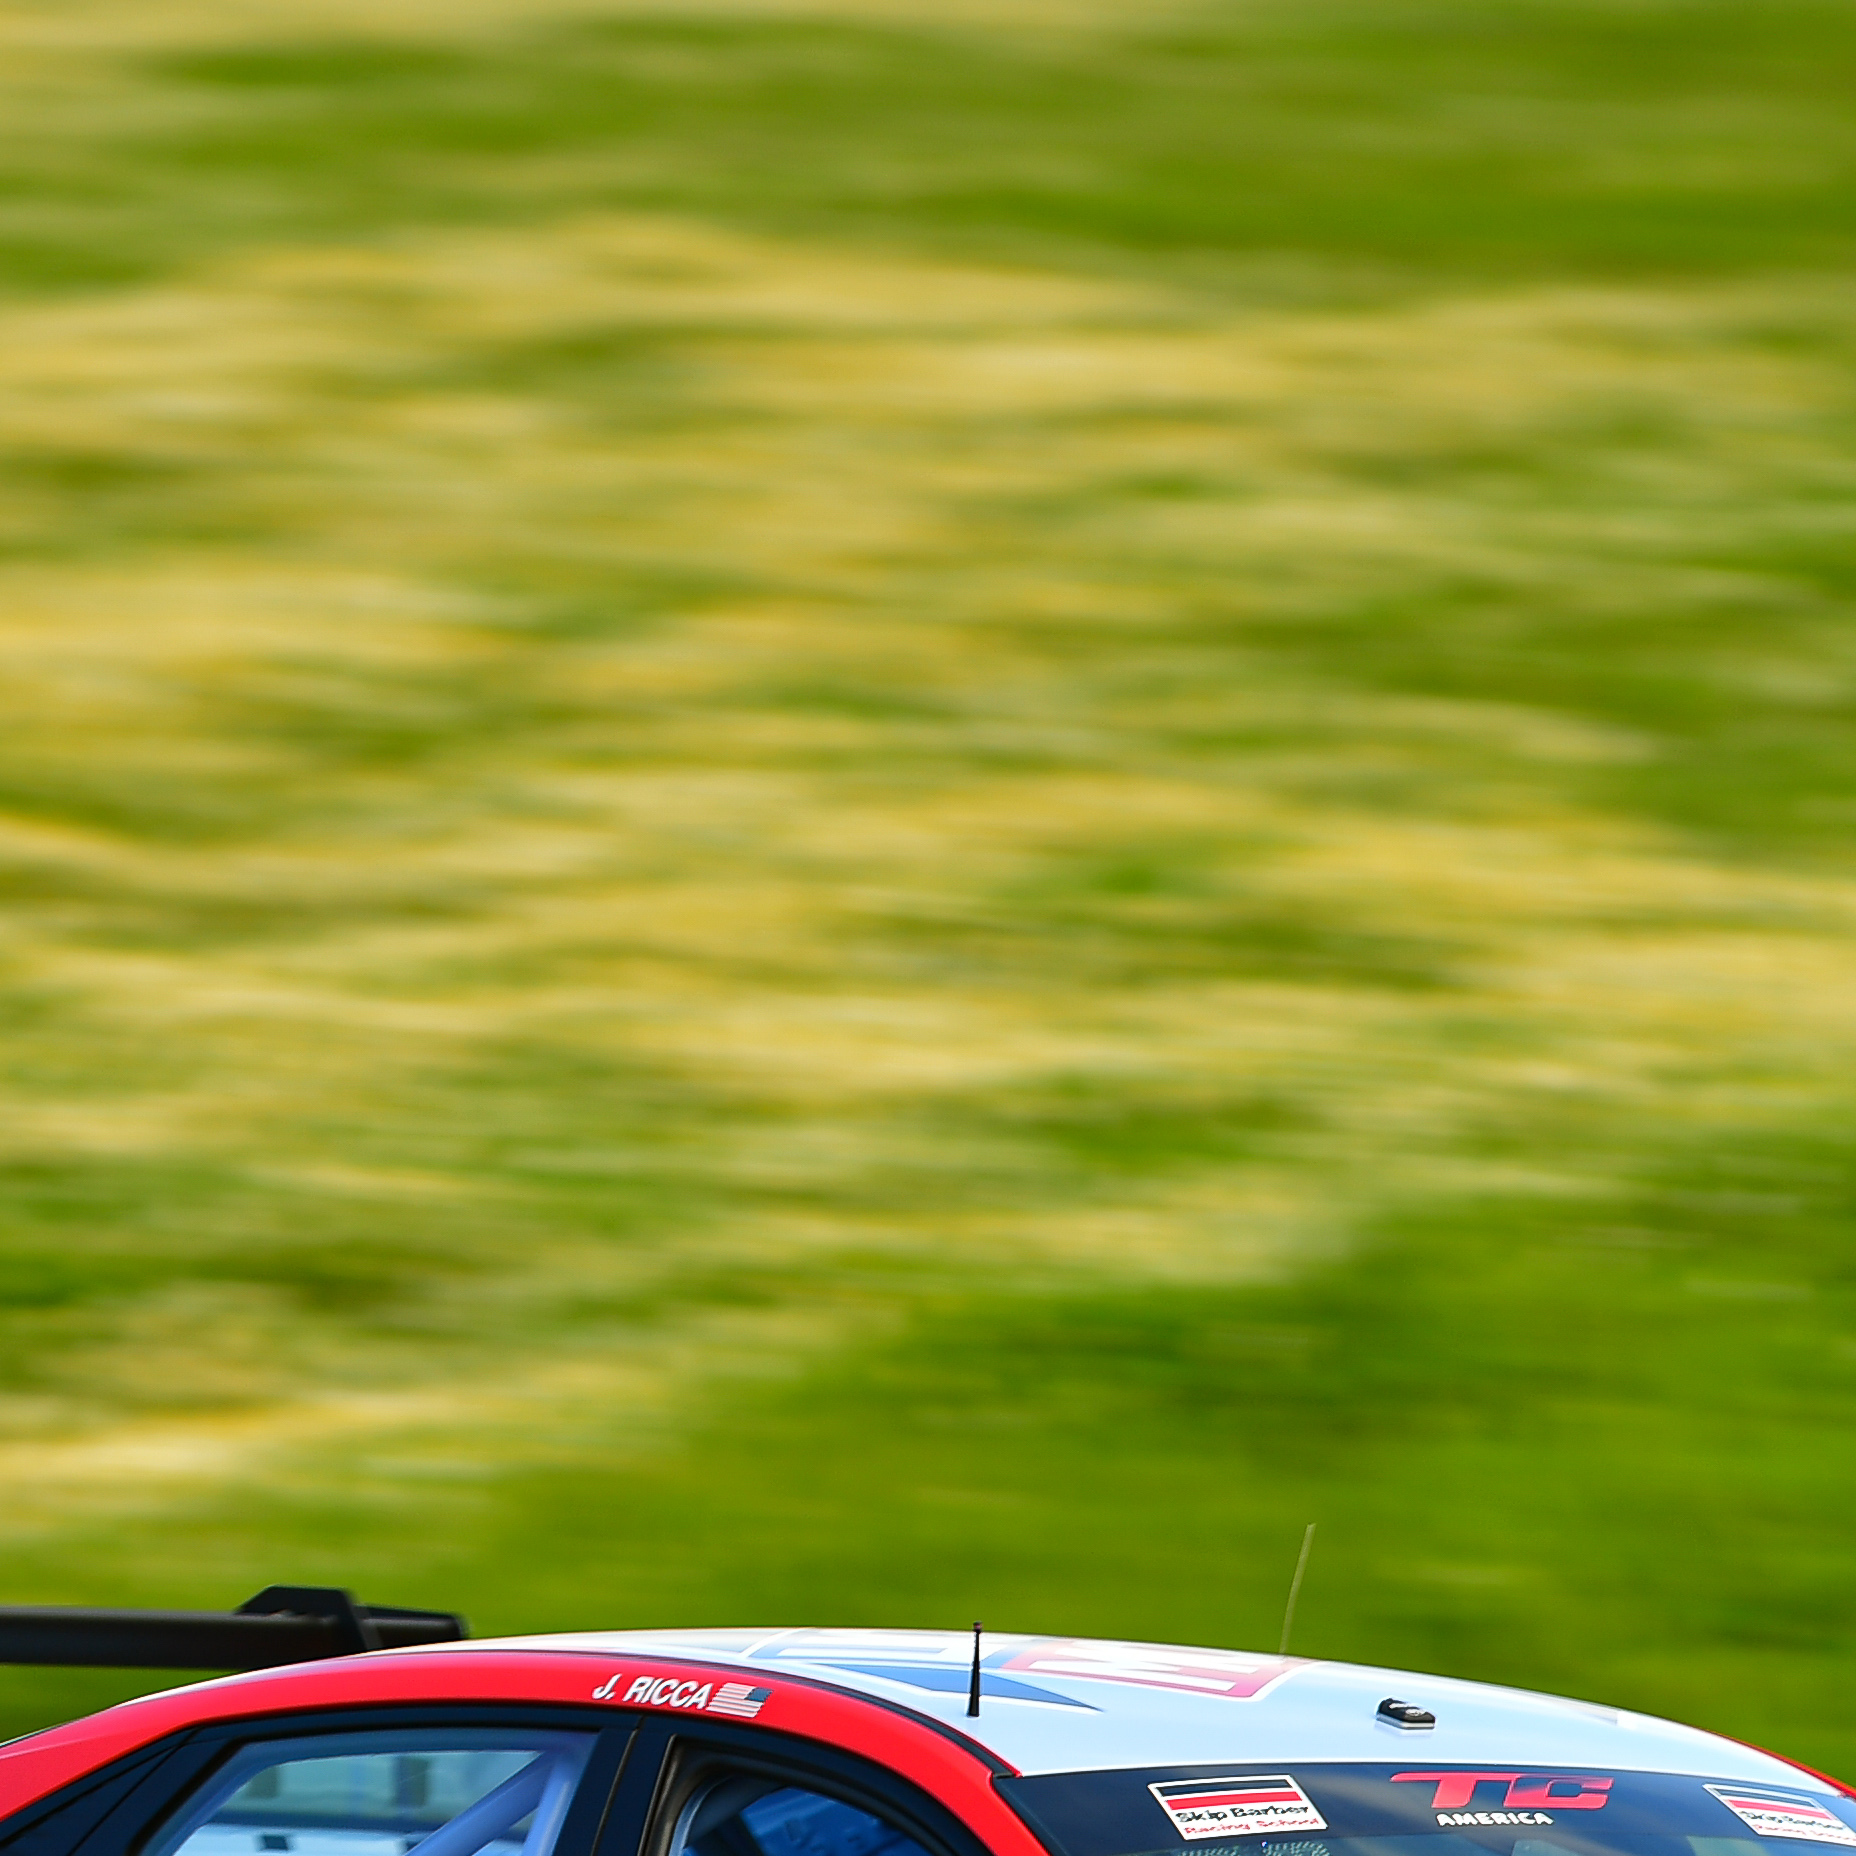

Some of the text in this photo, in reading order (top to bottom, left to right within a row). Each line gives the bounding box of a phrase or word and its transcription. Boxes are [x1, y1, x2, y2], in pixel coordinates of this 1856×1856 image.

[592, 1673, 713, 1710] J. RICCA
[1390, 1771, 1614, 1809] TC
[1229, 1805, 1309, 1819] Barber
[1436, 1812, 1554, 1826] AMERICA
